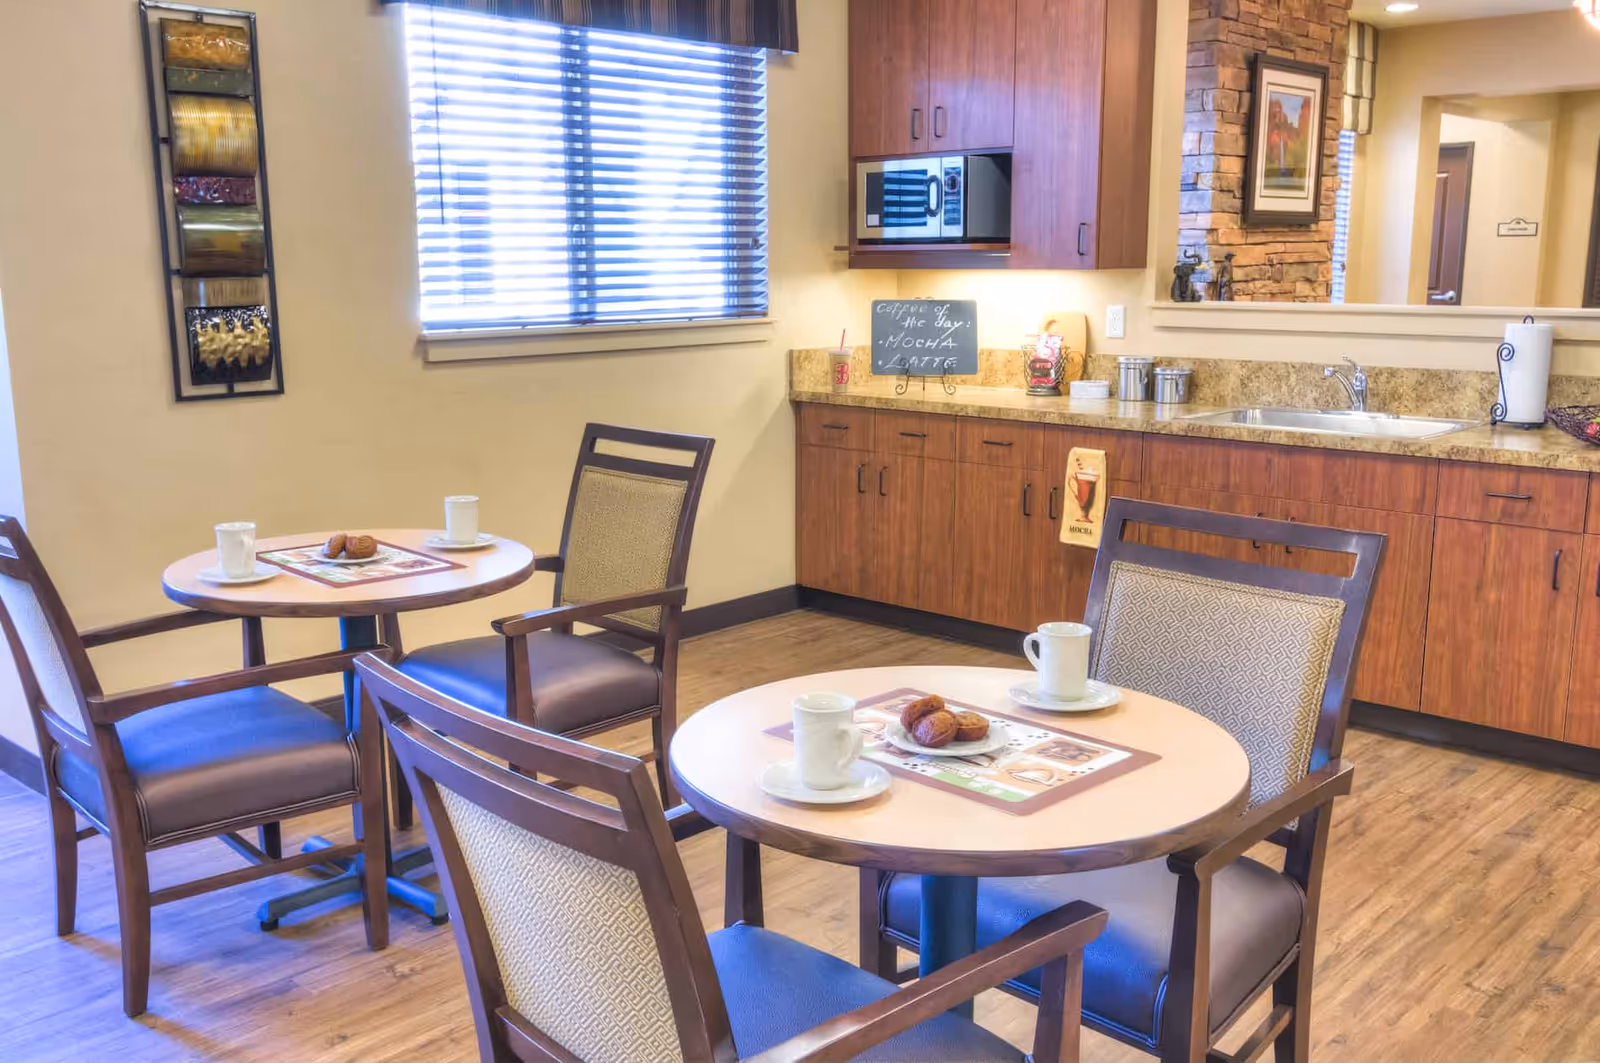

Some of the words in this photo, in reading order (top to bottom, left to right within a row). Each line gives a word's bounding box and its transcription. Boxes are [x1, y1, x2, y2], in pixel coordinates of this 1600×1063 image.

[876, 302, 928, 320] Coffee
[934, 303, 951, 319] of
[901, 316, 926, 328] the
[885, 331, 958, 349] MOCHA
[883, 353, 957, 369] LATTE
[1069, 525, 1092, 534] MOCHA
